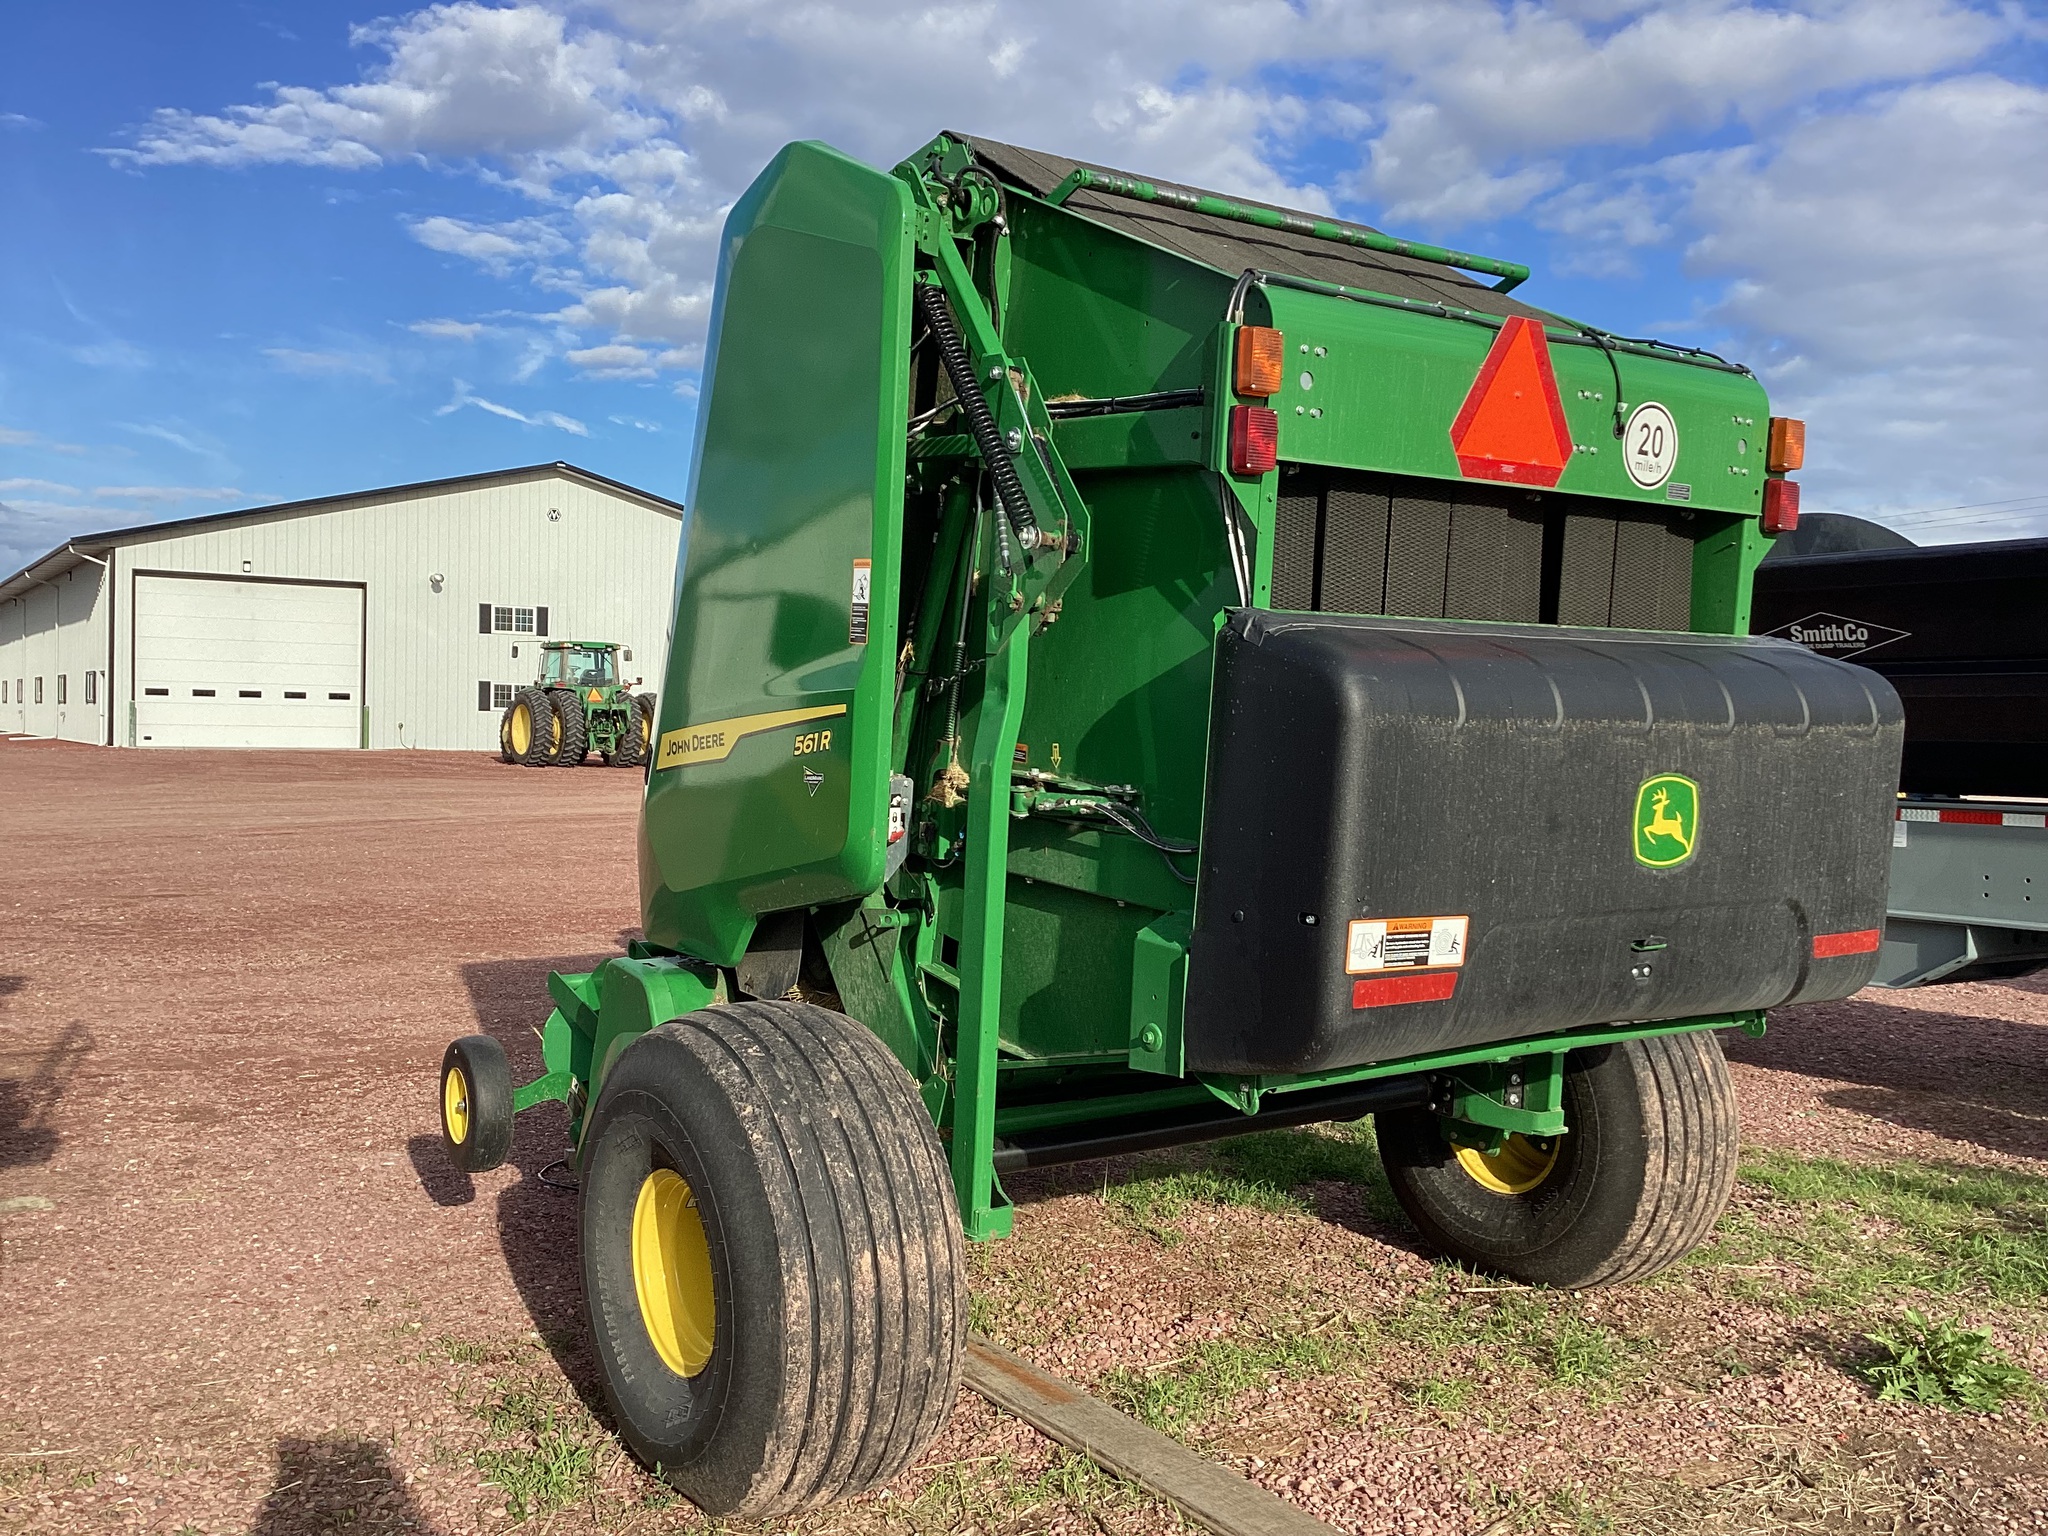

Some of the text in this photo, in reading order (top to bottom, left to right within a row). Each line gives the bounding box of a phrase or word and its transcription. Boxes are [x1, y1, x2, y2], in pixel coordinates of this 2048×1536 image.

[1637, 423, 1664, 459] 20
[1634, 461, 1662, 474] mile/h
[1789, 623, 1869, 643] SmithCo
[666, 732, 725, 757] JOHN DEERE
[1398, 923, 1427, 931] WARNING
